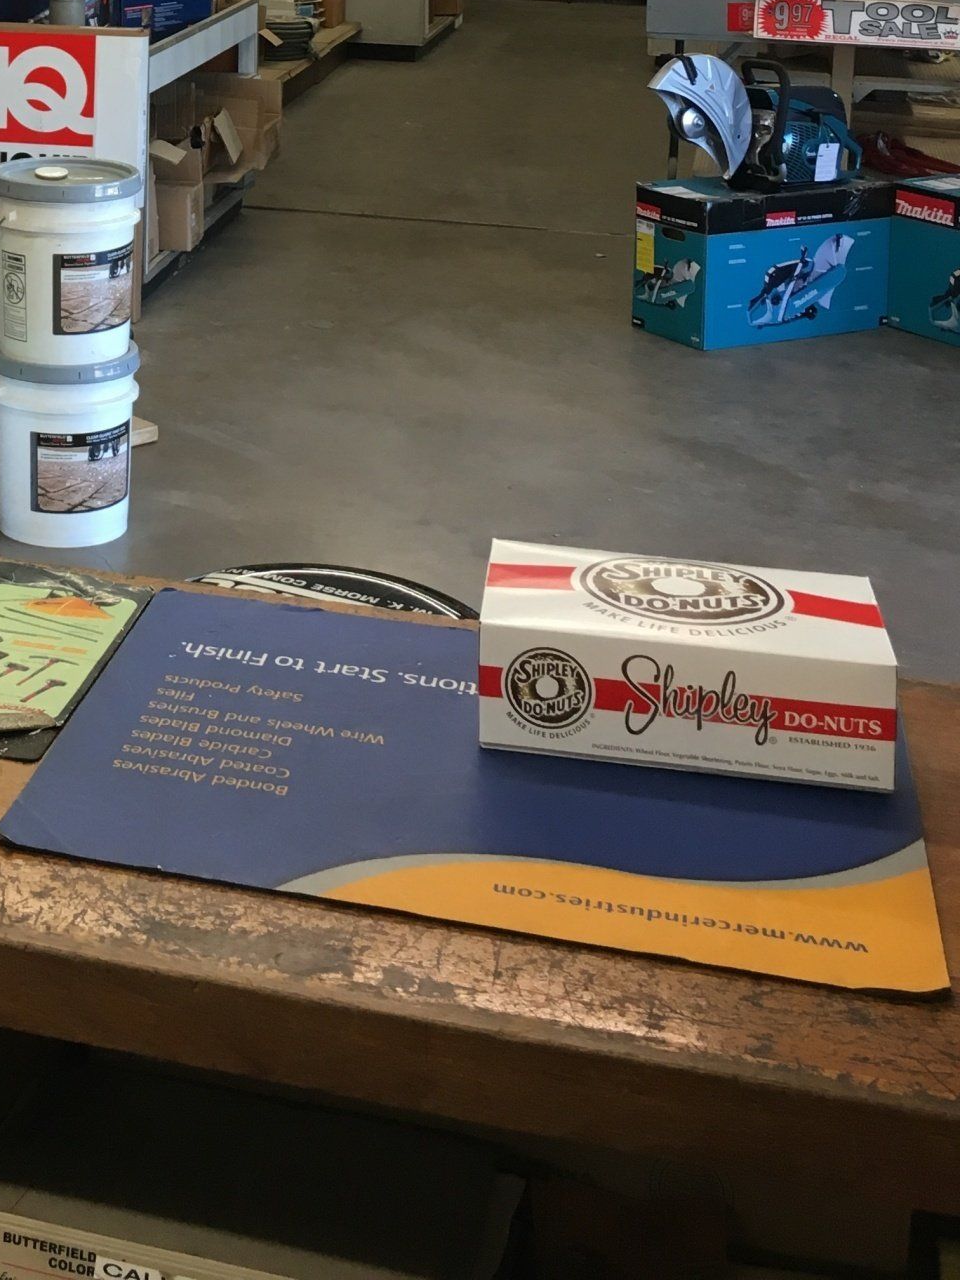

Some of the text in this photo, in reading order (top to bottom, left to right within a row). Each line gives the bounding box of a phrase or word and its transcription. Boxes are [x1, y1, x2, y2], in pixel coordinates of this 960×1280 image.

[821, 0, 959, 34] TOOL
[859, 20, 941, 39] SALE
[825, 34, 860, 42] REGAL
[606, 560, 757, 586] SHIPLEY
[310, 583, 381, 604] MORSE
[583, 599, 788, 638] MAKE LIFE DELICIOUS
[182, 640, 267, 667] Finish.
[275, 656, 305, 671] to
[315, 659, 388, 683] Start
[516, 659, 580, 684] SHIPLEY
[156, 687, 195, 702] Files
[163, 674, 304, 703] Safety Products
[621, 654, 776, 746] Shipley
[139, 714, 292, 747] Diamond Blades
[148, 700, 385, 746] Wire Wheels and Brushes
[505, 710, 592, 740] MAKE LIFE DELICIOUS
[784, 711, 882, 736] DO-NUTS
[131, 728, 272, 759] Carbide Blades
[788, 735, 877, 753] ESTABLISHED 1936
[122, 743, 290, 779] Coated Abrasives
[112, 758, 289, 797] Bonded Abrasives
[493, 882, 870, 954] www.mercerindustries.com
[2, 1231, 97, 1263] BUTTERFIELD
[48, 1257, 96, 1277] COLOR
